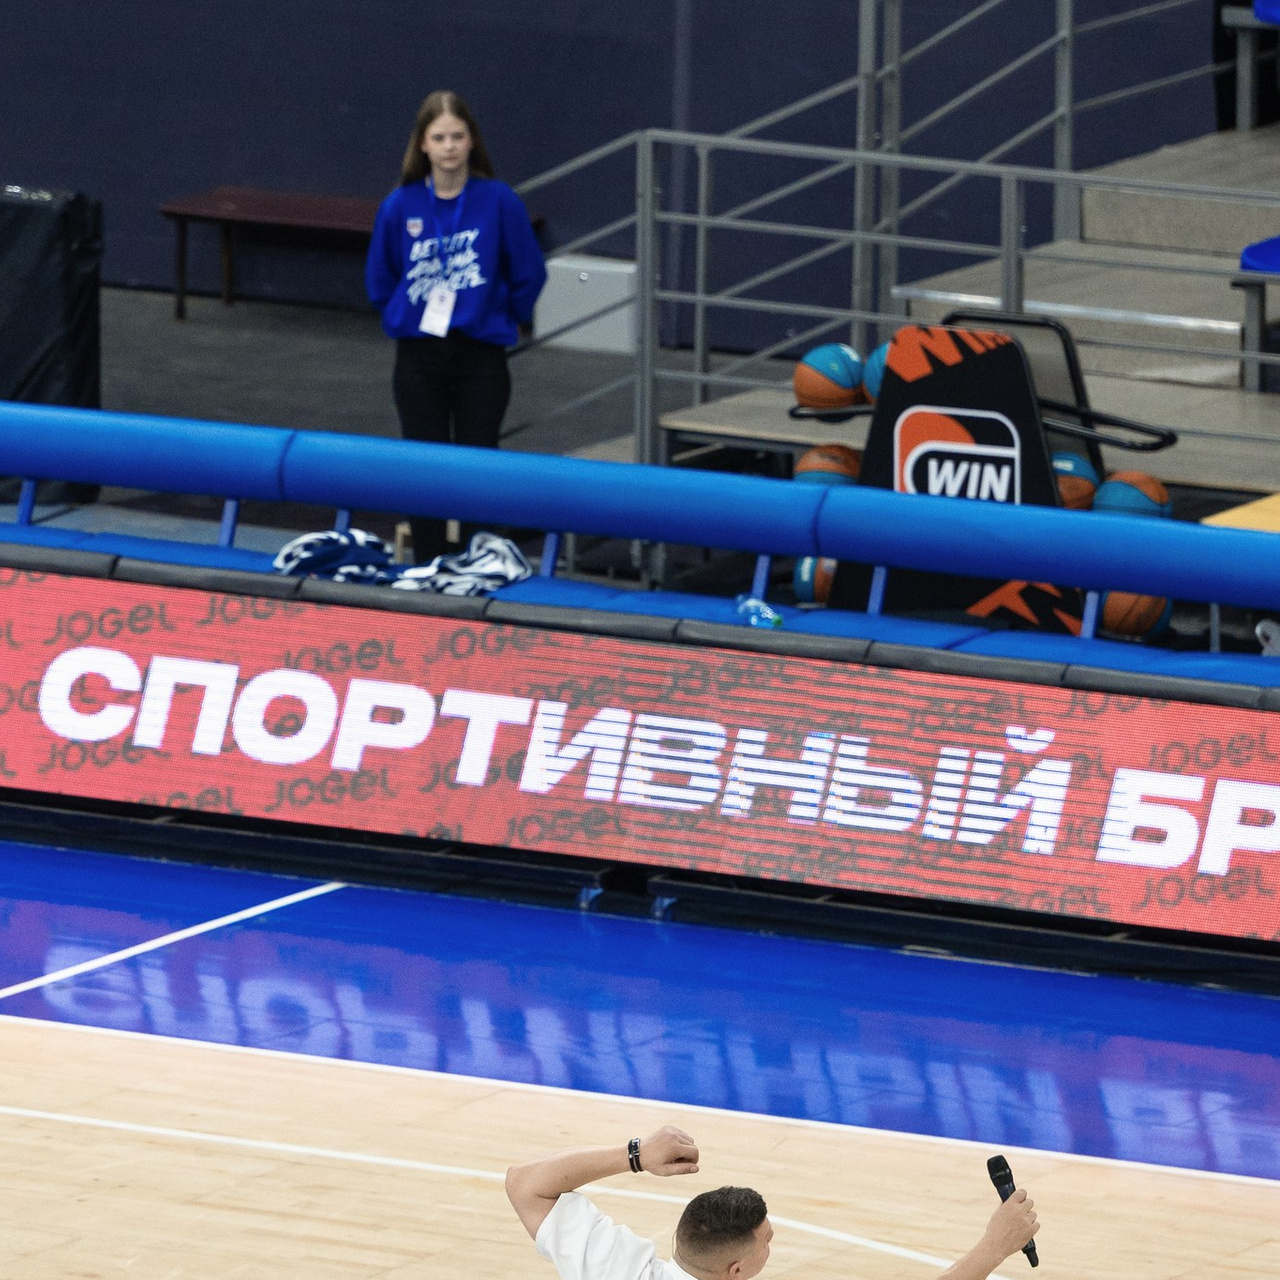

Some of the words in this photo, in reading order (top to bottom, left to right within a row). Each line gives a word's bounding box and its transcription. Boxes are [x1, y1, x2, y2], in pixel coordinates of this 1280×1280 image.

[926, 457, 1012, 502] WIN
[37, 645, 1074, 856] СПОРТИВНЫЙ
[1095, 767, 1280, 877] БР
